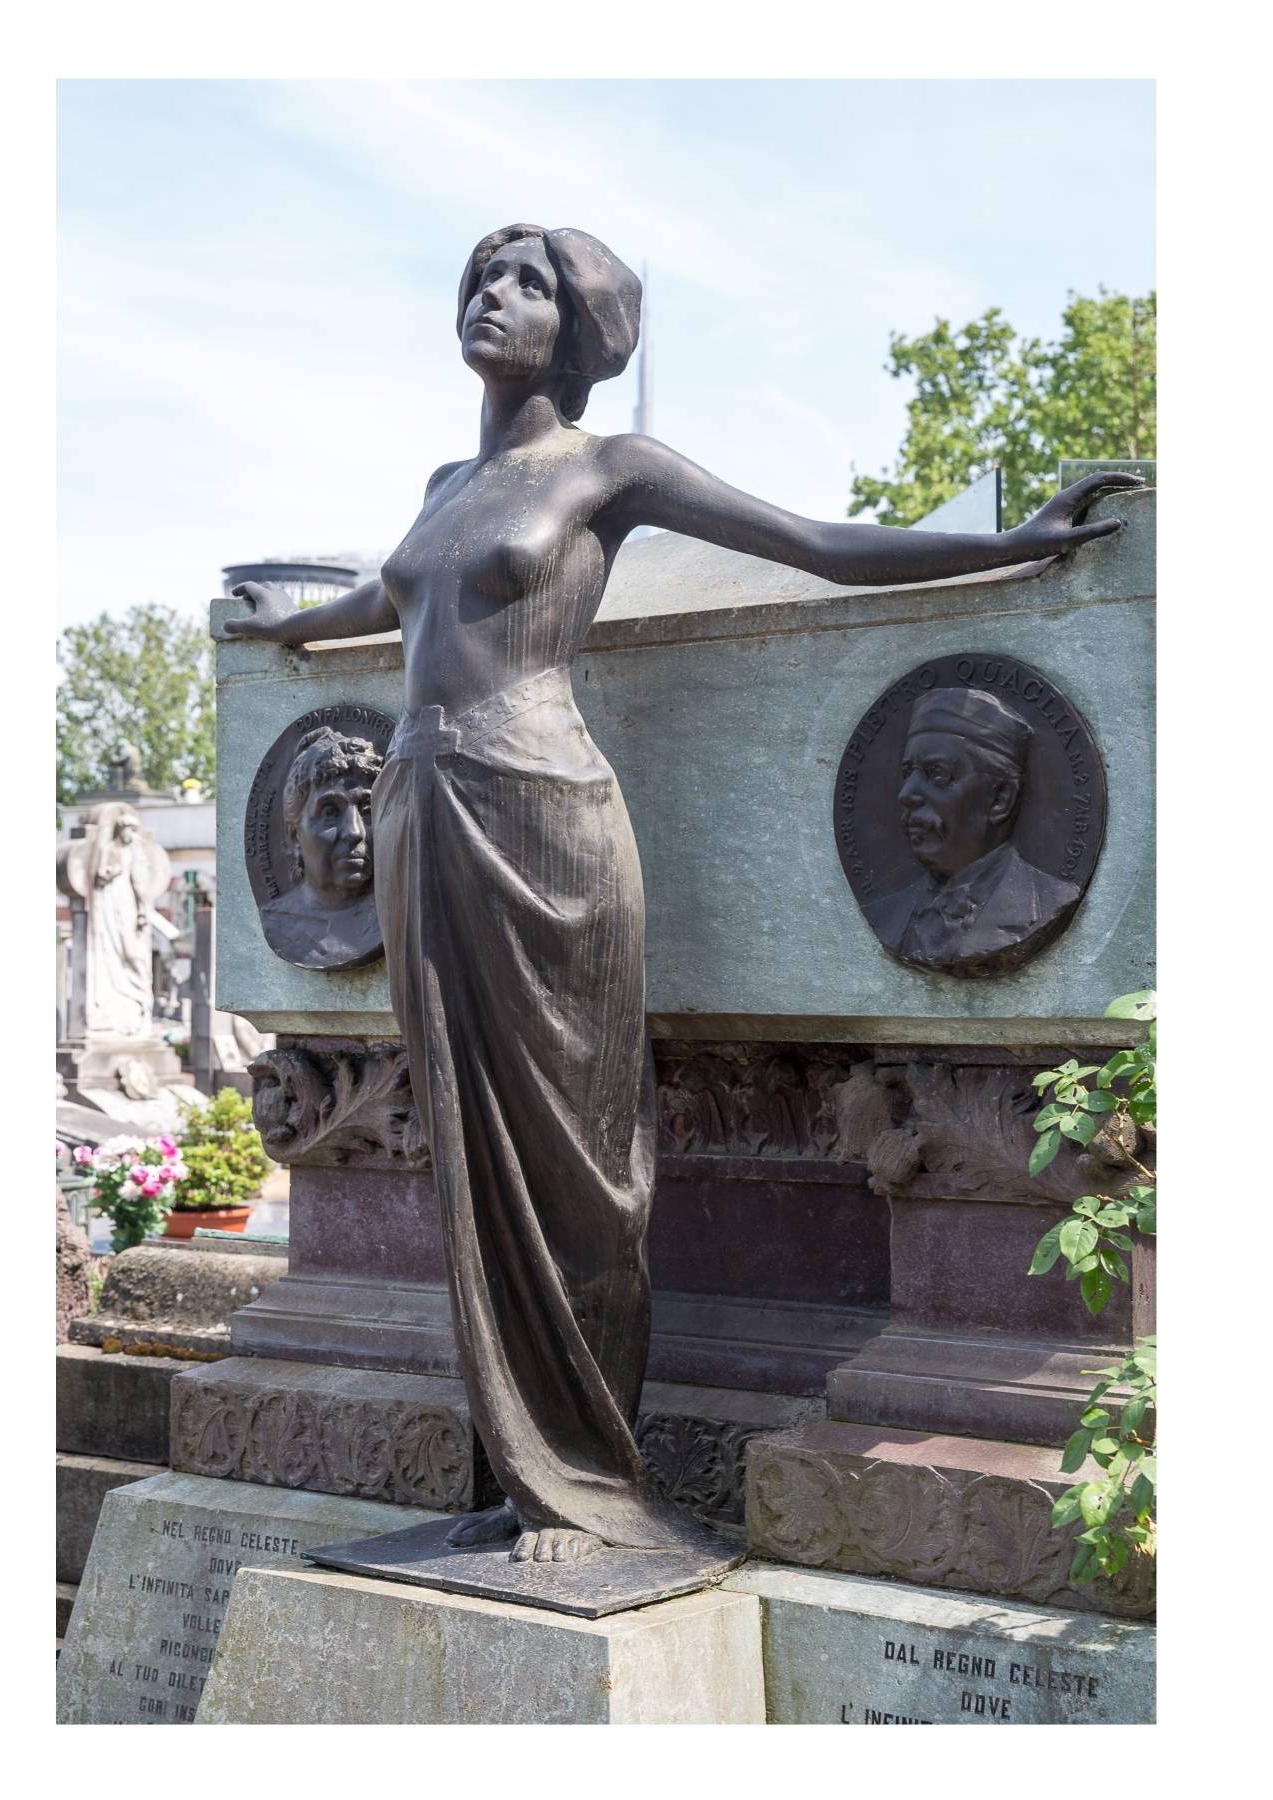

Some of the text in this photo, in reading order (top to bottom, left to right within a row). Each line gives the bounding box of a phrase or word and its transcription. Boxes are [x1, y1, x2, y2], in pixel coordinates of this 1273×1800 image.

[846, 668, 937, 766] PIETRO
[956, 659, 1078, 749] QUAGLIA
[162, 1519, 299, 1556] NEL REGNO CELESTE
[109, 1659, 124, 1677] AL
[135, 1664, 159, 1683] TUO
[884, 1640, 1100, 1699] DAL REGNO CELESTE
[961, 1690, 1011, 1720] DOVE
